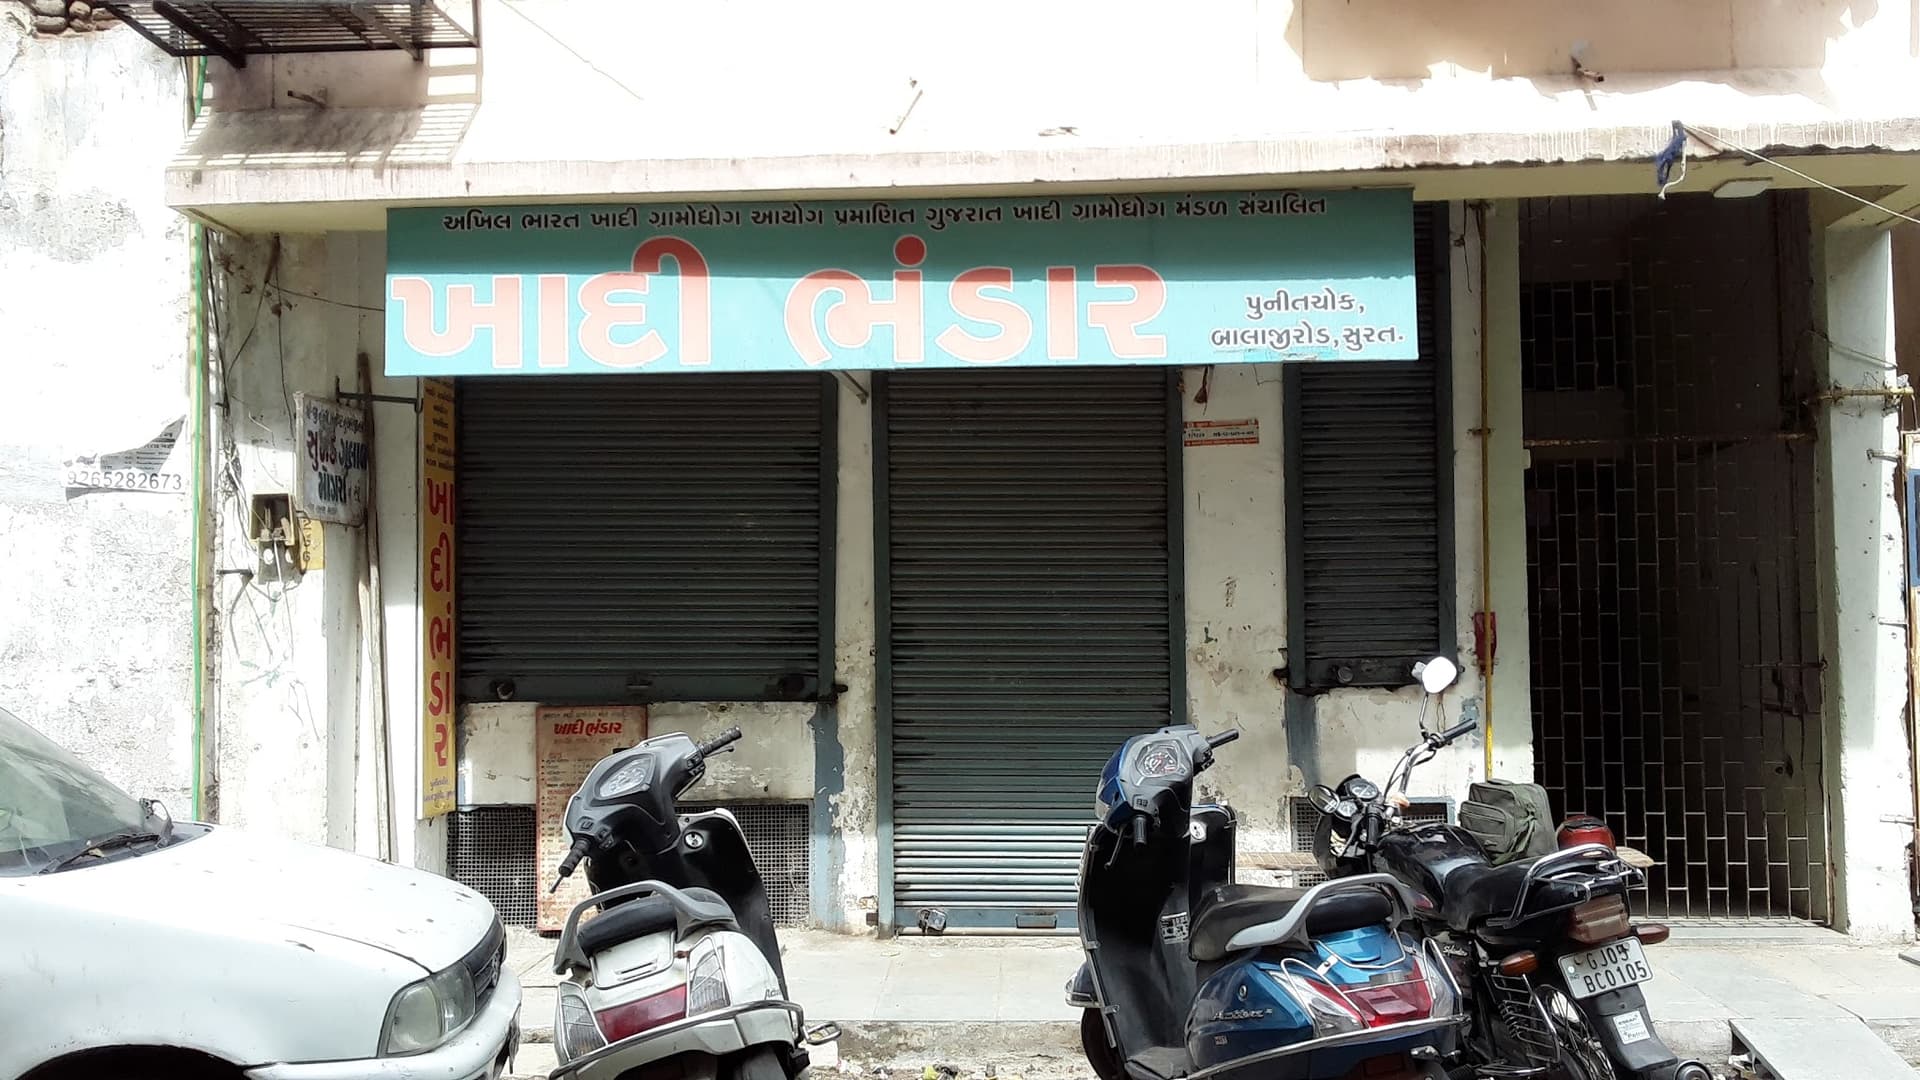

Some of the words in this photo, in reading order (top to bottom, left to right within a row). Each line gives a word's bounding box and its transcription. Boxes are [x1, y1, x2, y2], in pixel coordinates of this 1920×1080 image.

[443, 209, 512, 231] અખિલ
[520, 210, 580, 230] ભારત
[590, 207, 638, 228] ખાદી
[751, 203, 824, 226] આયોગ
[834, 203, 916, 226] પ્રમાણિત
[926, 206, 1002, 231] ગુજરાત
[1013, 198, 1061, 220] ખાદી
[1175, 194, 1228, 217] મંડળ
[1238, 193, 1326, 216] સંચાલિત
[390, 235, 712, 369] ખાદી
[784, 234, 1168, 368] ભંડાર
[67, 471, 182, 490] 9265282673
[553, 719, 584, 735] ખાદી
[585, 718, 622, 736] ભંડાર
[1586, 944, 1630, 970] GJ05
[1583, 961, 1648, 994] BC0105
